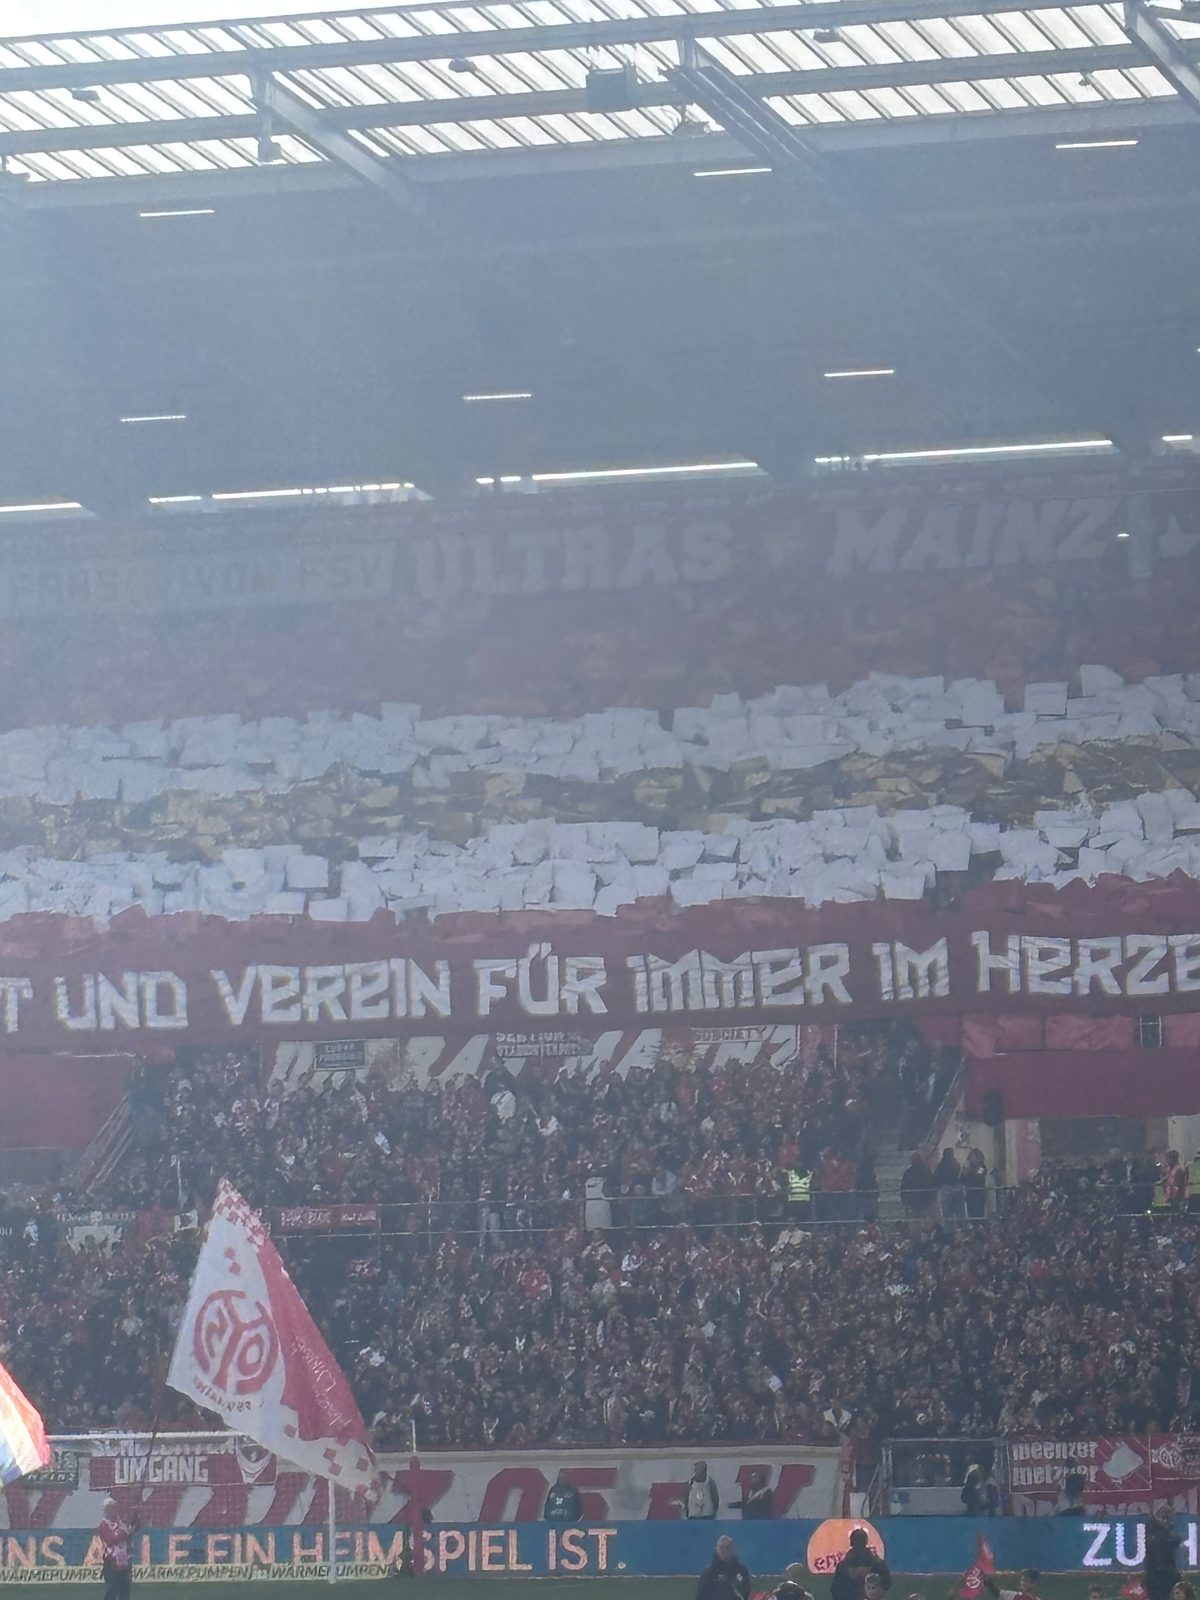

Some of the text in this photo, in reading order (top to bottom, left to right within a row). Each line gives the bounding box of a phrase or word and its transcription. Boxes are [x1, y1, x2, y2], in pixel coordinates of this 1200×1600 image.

[410, 499, 1123, 598] ULTRAS MAINZ
[298, 553, 381, 592] FSV
[55, 969, 189, 1031] UND
[210, 958, 451, 1026] VEREIN
[473, 942, 607, 1016] FÜR
[627, 943, 852, 1012] IMMER
[873, 937, 950, 1000] IM
[114, 1456, 209, 1484] UMGANG
[0, 1534, 67, 1567] NS
[548, 1528, 627, 1571] IST.
[1082, 1522, 1147, 1567] ZU
[0, 1567, 105, 1582] WÄRMEPUMPE
